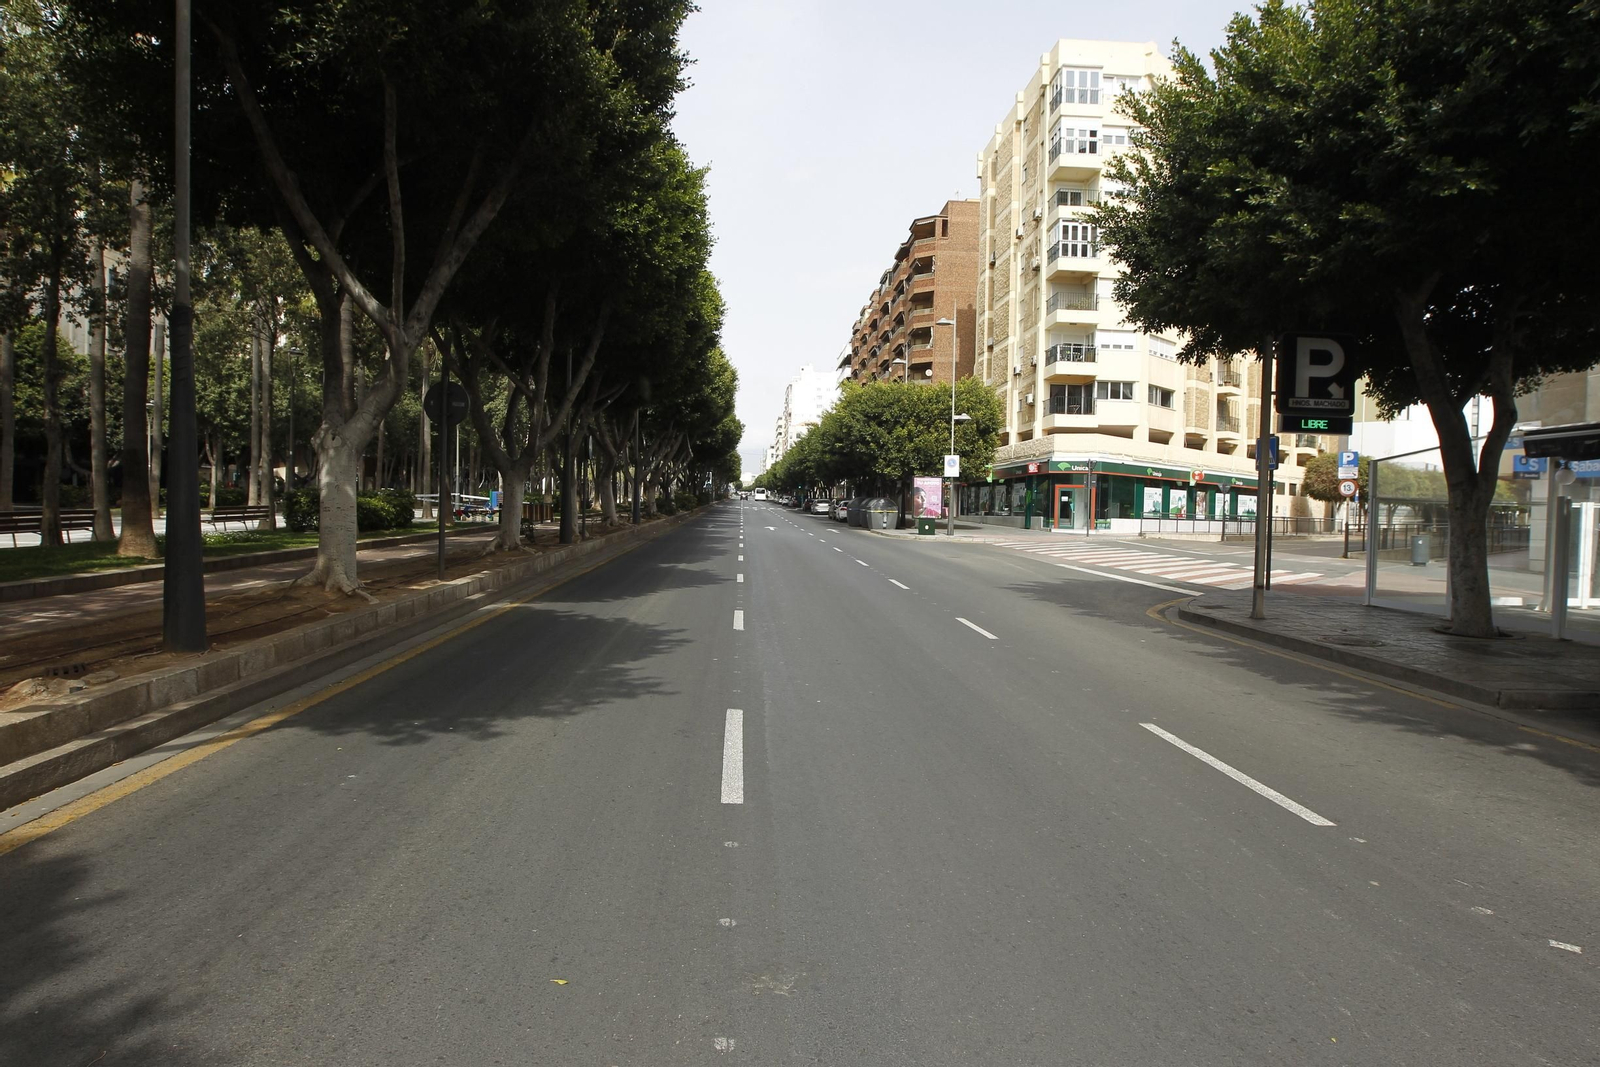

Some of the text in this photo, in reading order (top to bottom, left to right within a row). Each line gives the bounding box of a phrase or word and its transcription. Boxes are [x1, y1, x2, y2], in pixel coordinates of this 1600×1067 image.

[1295, 337, 1345, 398] P
[1301, 419, 1328, 429] LIBRE
[1342, 452, 1354, 464] P
